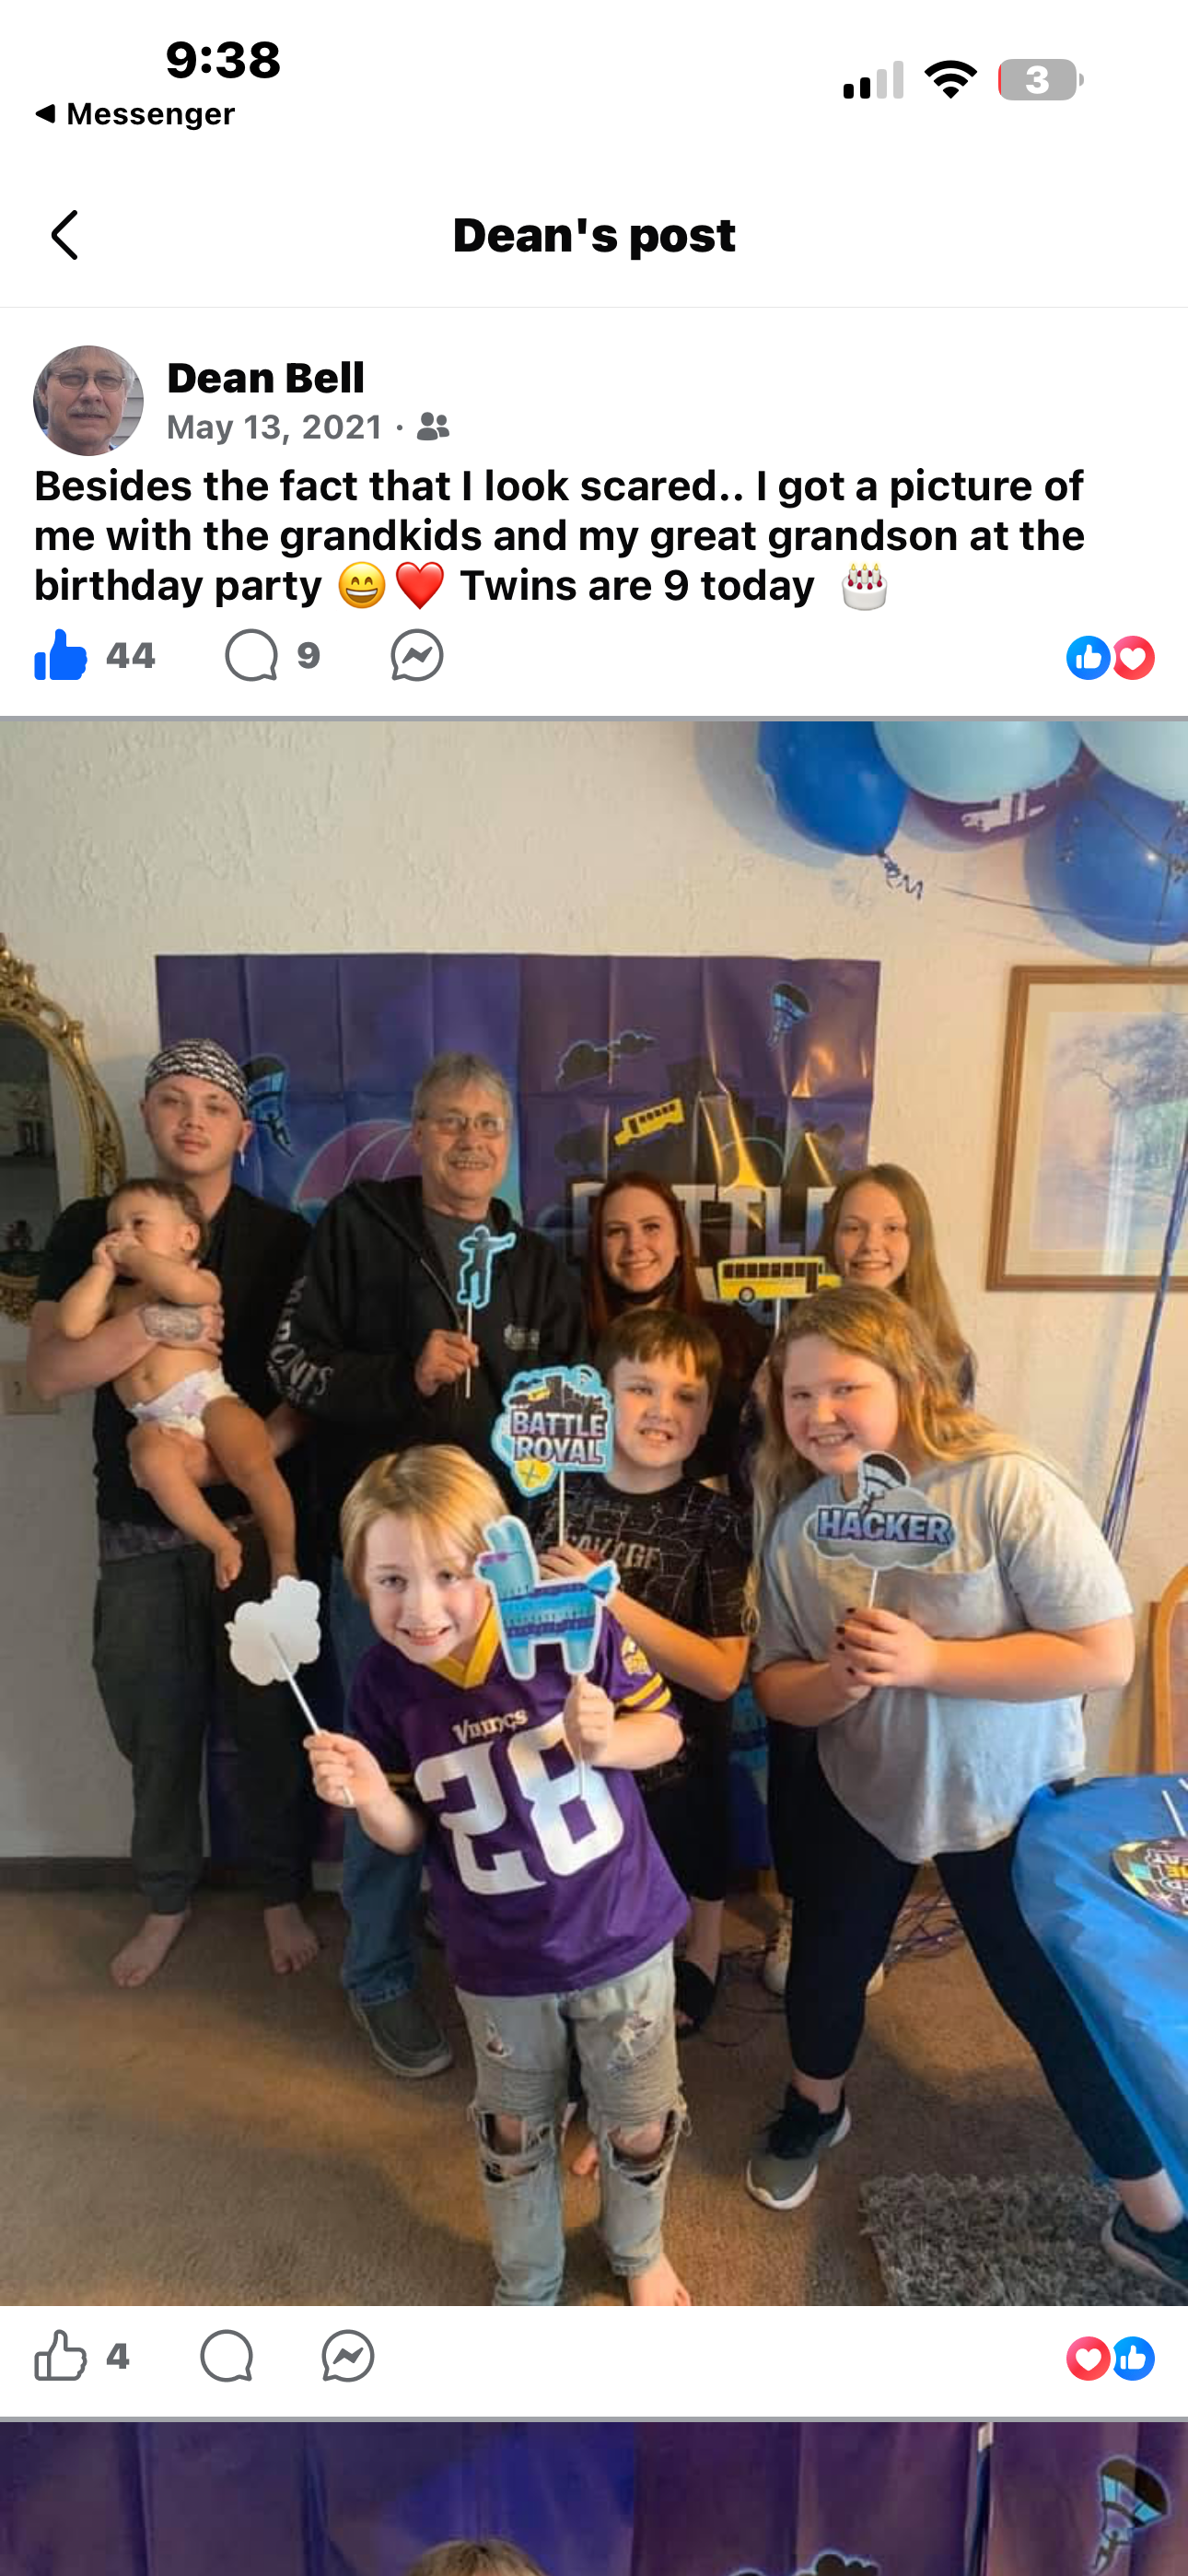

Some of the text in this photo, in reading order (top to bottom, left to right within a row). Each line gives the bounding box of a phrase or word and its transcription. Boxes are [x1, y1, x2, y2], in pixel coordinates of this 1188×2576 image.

[166, 41, 281, 79] 9:38
[1025, 64, 1050, 95] 3
[67, 102, 236, 131] Messenger
[454, 217, 736, 261] Dean's post
[168, 360, 364, 394] Dean Bell
[168, 414, 381, 446] May 13, 2021
[36, 467, 1085, 509] Besides the fact that I look scared.. I got a picture of
[35, 517, 1085, 559] me with the grandkids and my great grandson at the
[35, 567, 816, 609] birthday party Twins are 9 today
[106, 642, 156, 669] 44
[297, 641, 320, 670] 9
[512, 1410, 607, 1438] BATTLE
[514, 1436, 604, 1463] ROYAL
[818, 1508, 951, 1544] HACKER
[414, 1711, 624, 1895] 28
[106, 2343, 130, 2370] 4
